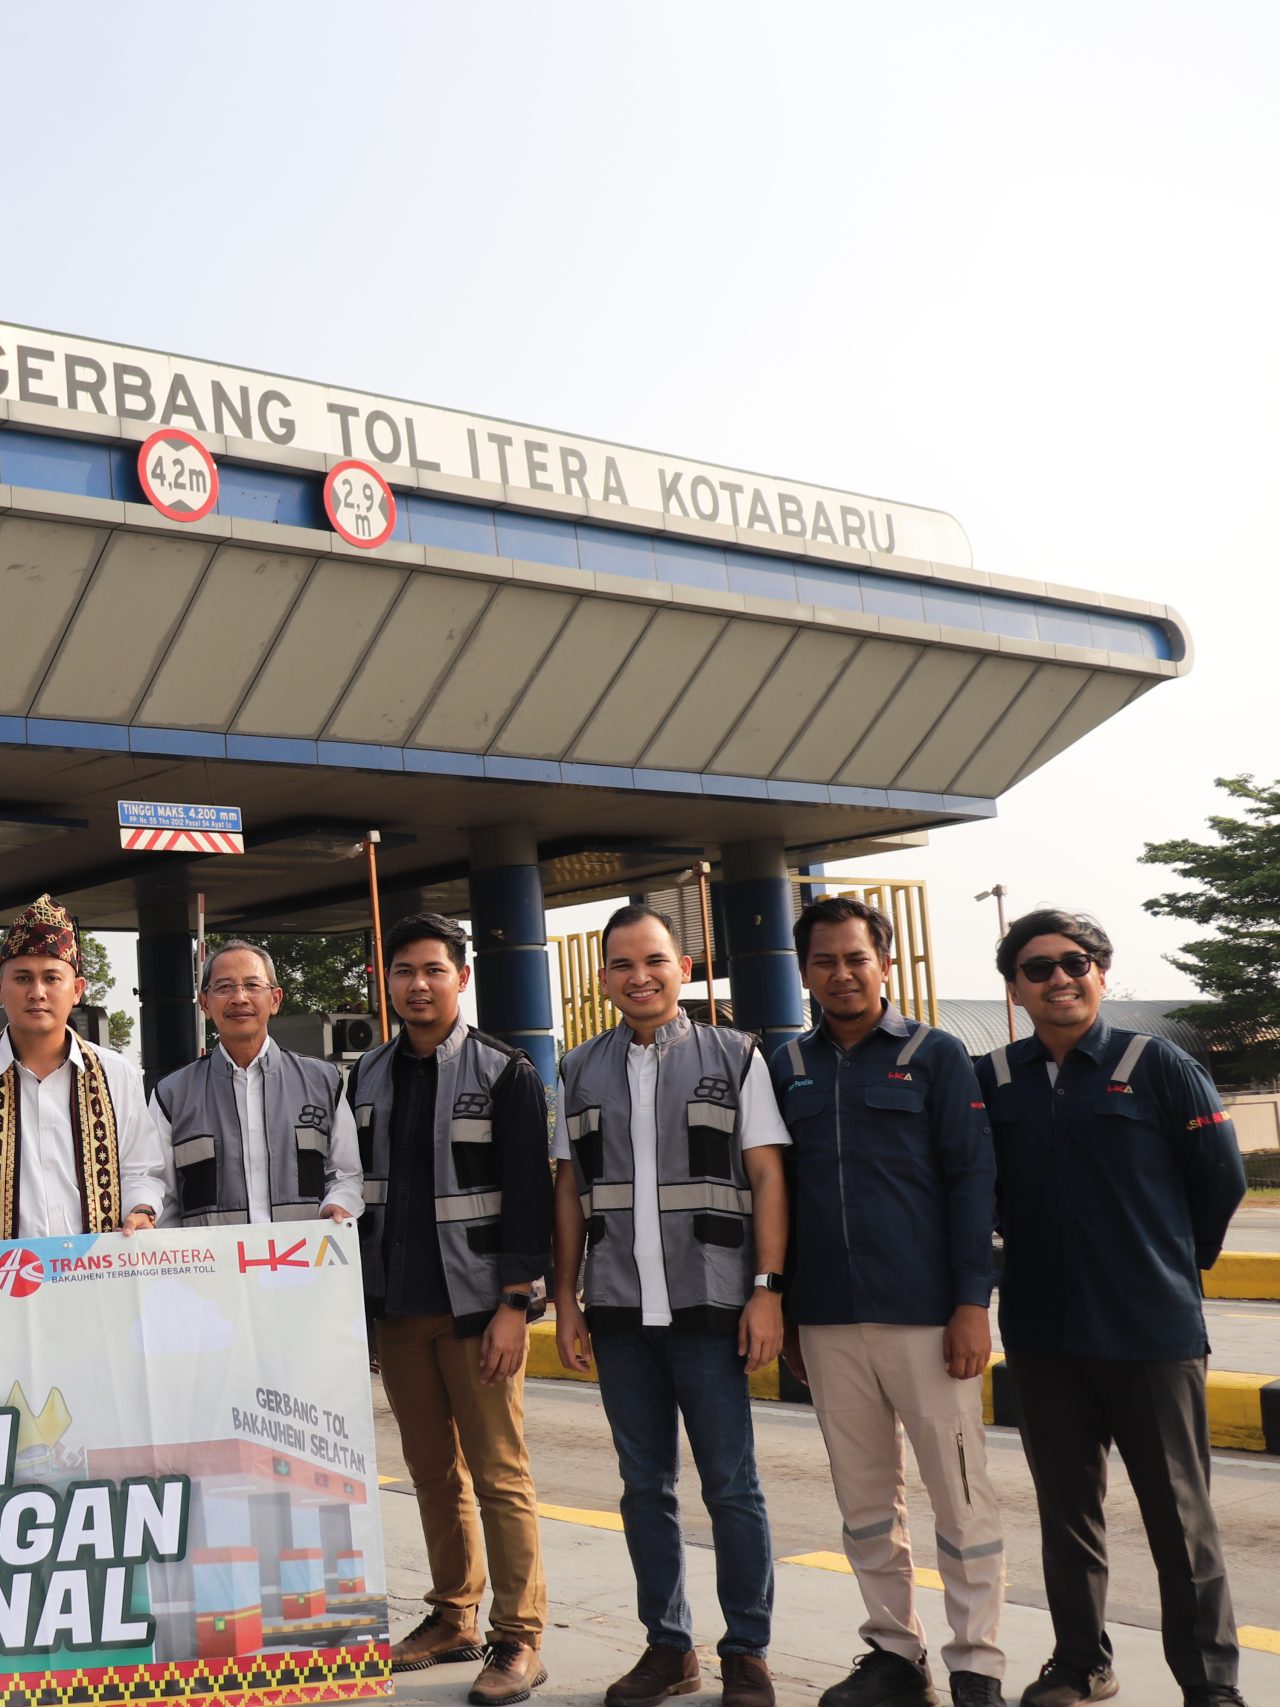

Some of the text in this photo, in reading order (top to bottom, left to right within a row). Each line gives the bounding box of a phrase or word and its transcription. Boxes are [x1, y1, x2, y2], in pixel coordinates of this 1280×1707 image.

[151, 455, 208, 494] 4,2m
[326, 402, 441, 472] TOL
[467, 428, 629, 505] ITERA
[657, 468, 896, 554] KOTABARU
[341, 478, 375, 513] 2,9
[355, 513, 372, 537] m
[122, 804, 237, 820] TINGGI MAKS. 4.200 mm
[49, 1248, 215, 1273] TRANS SUMATERA
[51, 1266, 216, 1284] BAKAUHENI TERBANGGI BESAR TOLL
[256, 1387, 349, 1440] GERBANG TOL
[232, 1407, 366, 1475] BAKAUHENI SELATAN
